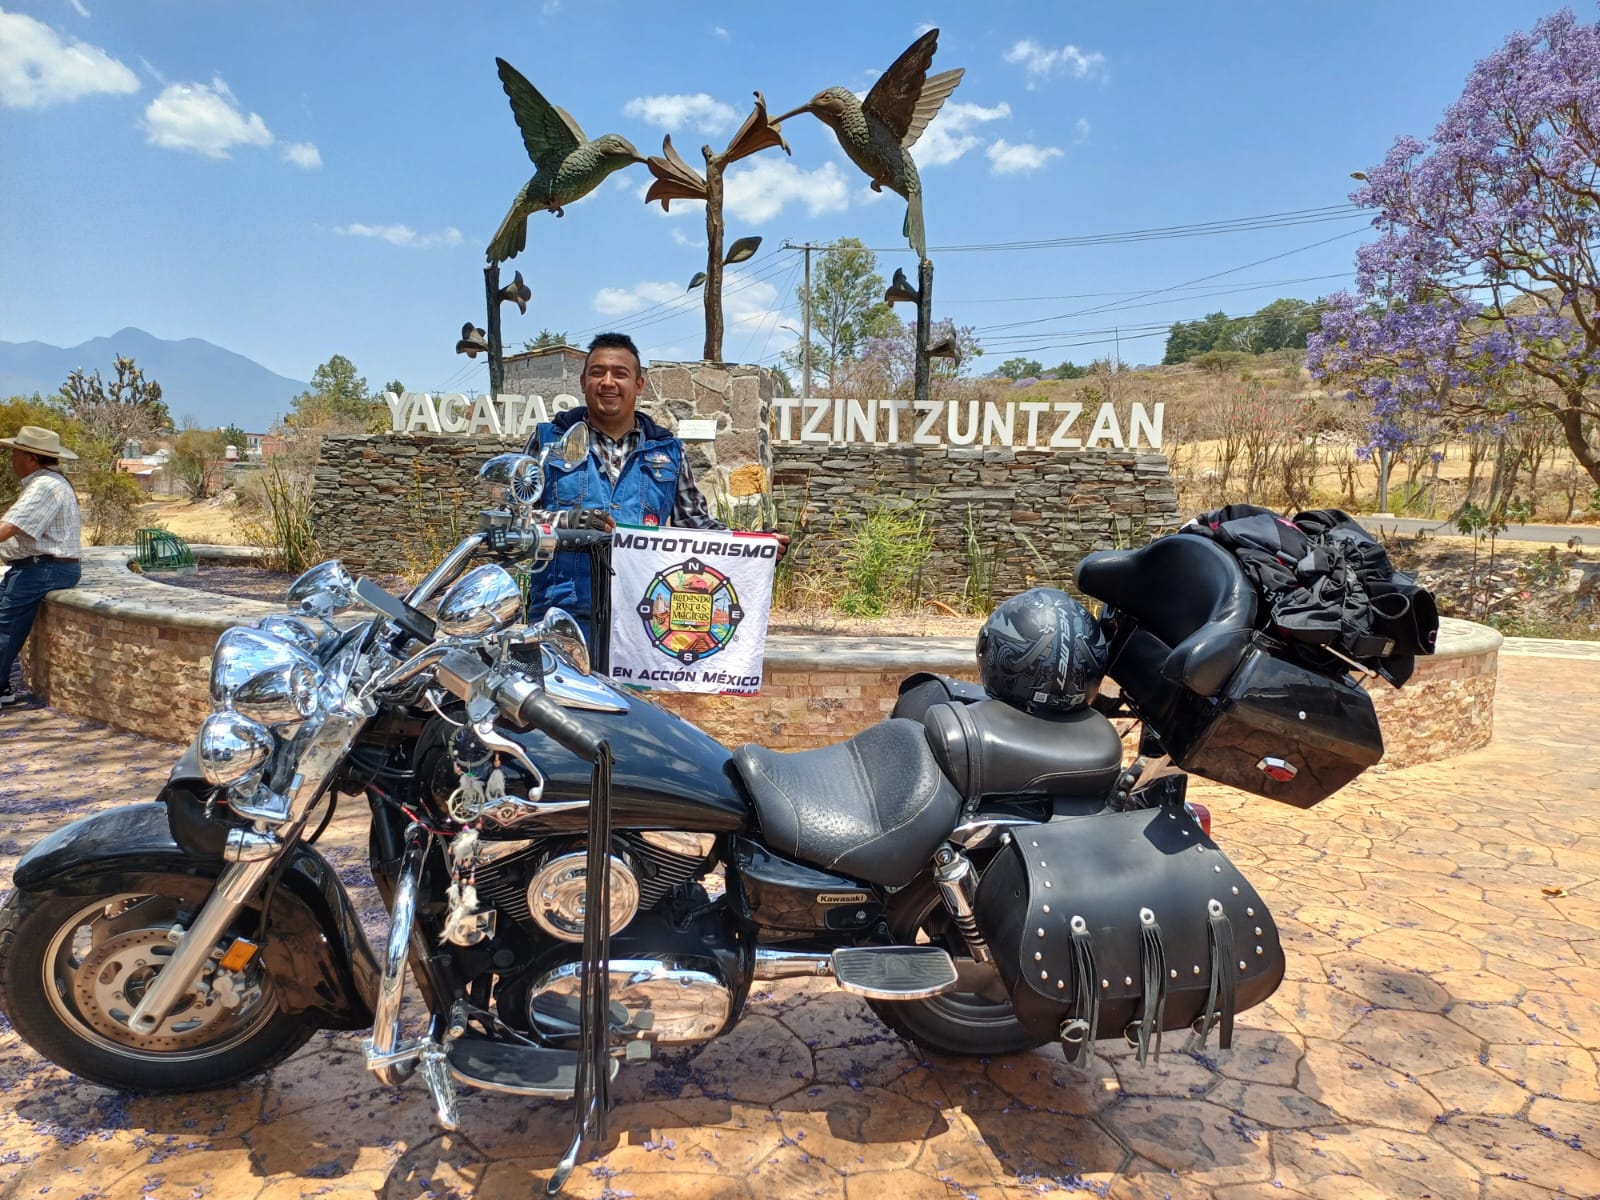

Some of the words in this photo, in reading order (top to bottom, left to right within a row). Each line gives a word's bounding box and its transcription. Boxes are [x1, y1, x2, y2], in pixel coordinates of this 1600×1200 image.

[772, 398, 1165, 450] TZINTZUNTZAN
[688, 562, 700, 571] N
[640, 605, 651, 614] O
[732, 610, 741, 619] E
[1057, 607, 1071, 691] HELMET
[683, 653, 693, 661] S
[612, 666, 633, 678] EN
[638, 667, 697, 682] ACCIÓN
[702, 670, 760, 687] MÉXICO
[820, 895, 863, 903] Kawasaki
